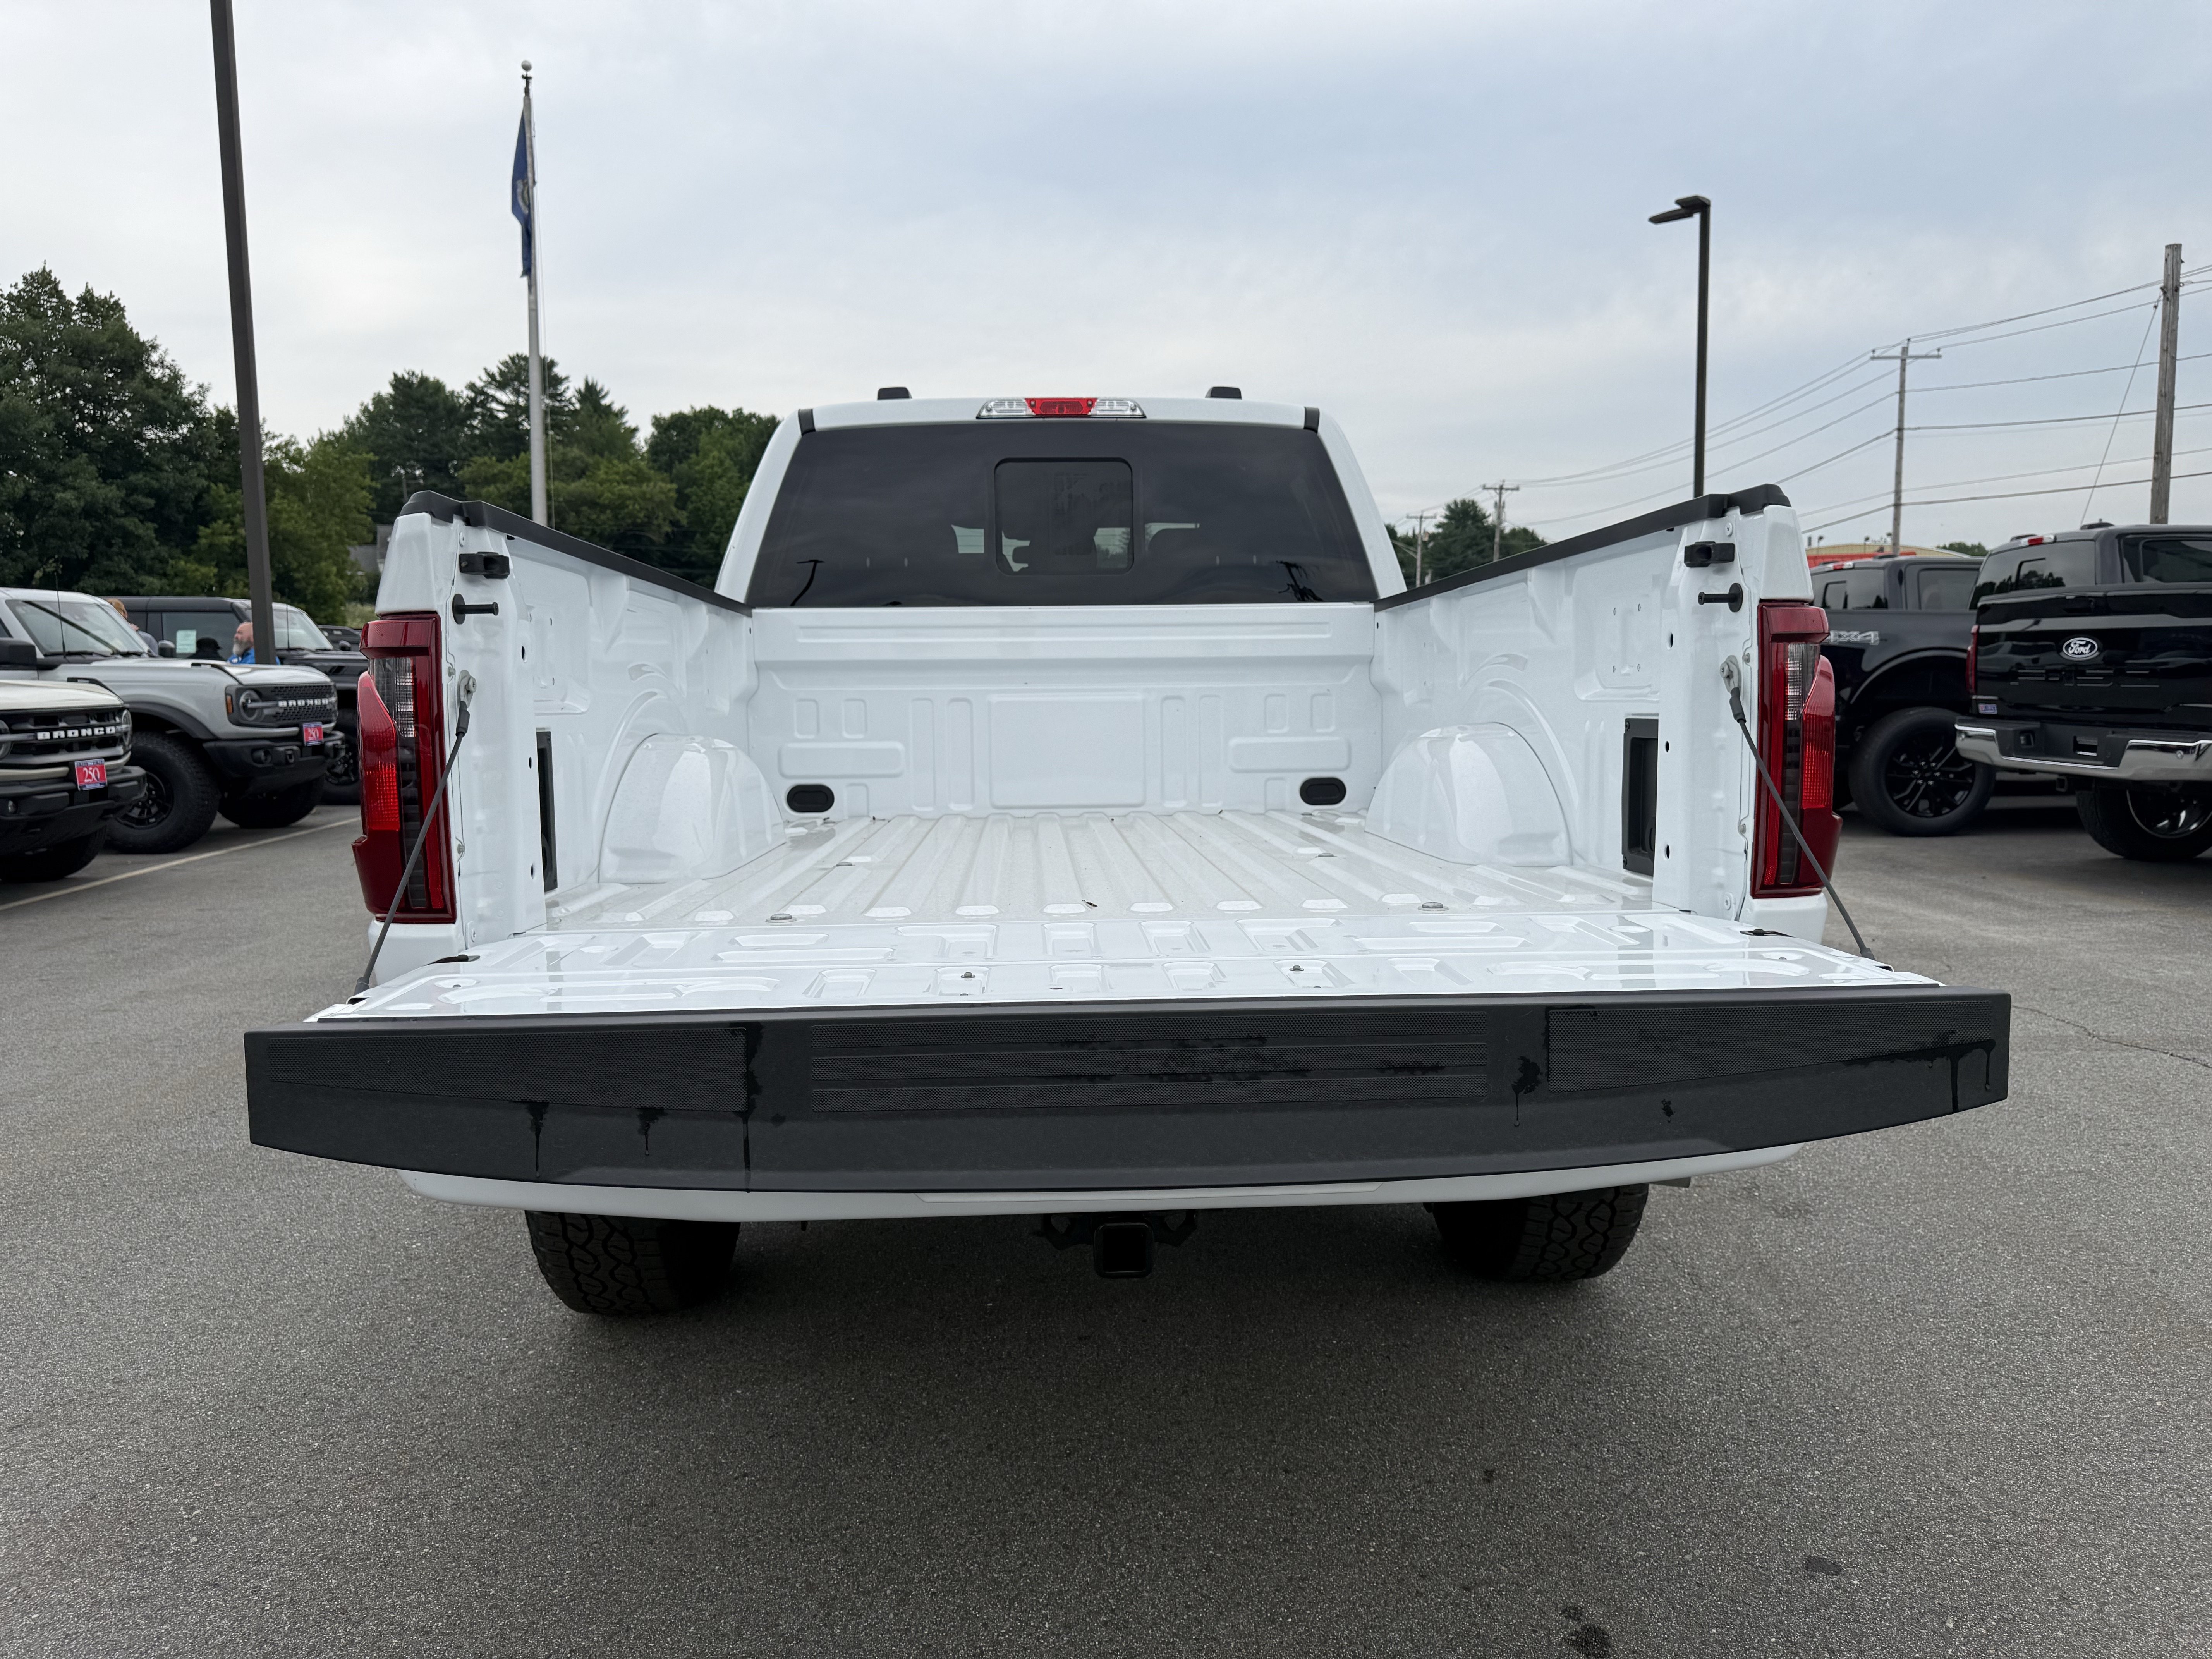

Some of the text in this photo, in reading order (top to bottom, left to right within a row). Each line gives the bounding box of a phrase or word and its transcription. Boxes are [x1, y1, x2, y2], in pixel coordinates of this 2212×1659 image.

[2068, 640, 2092, 654] Ford
[37, 726, 115, 740] BRONCO
[83, 767, 100, 783] 250
